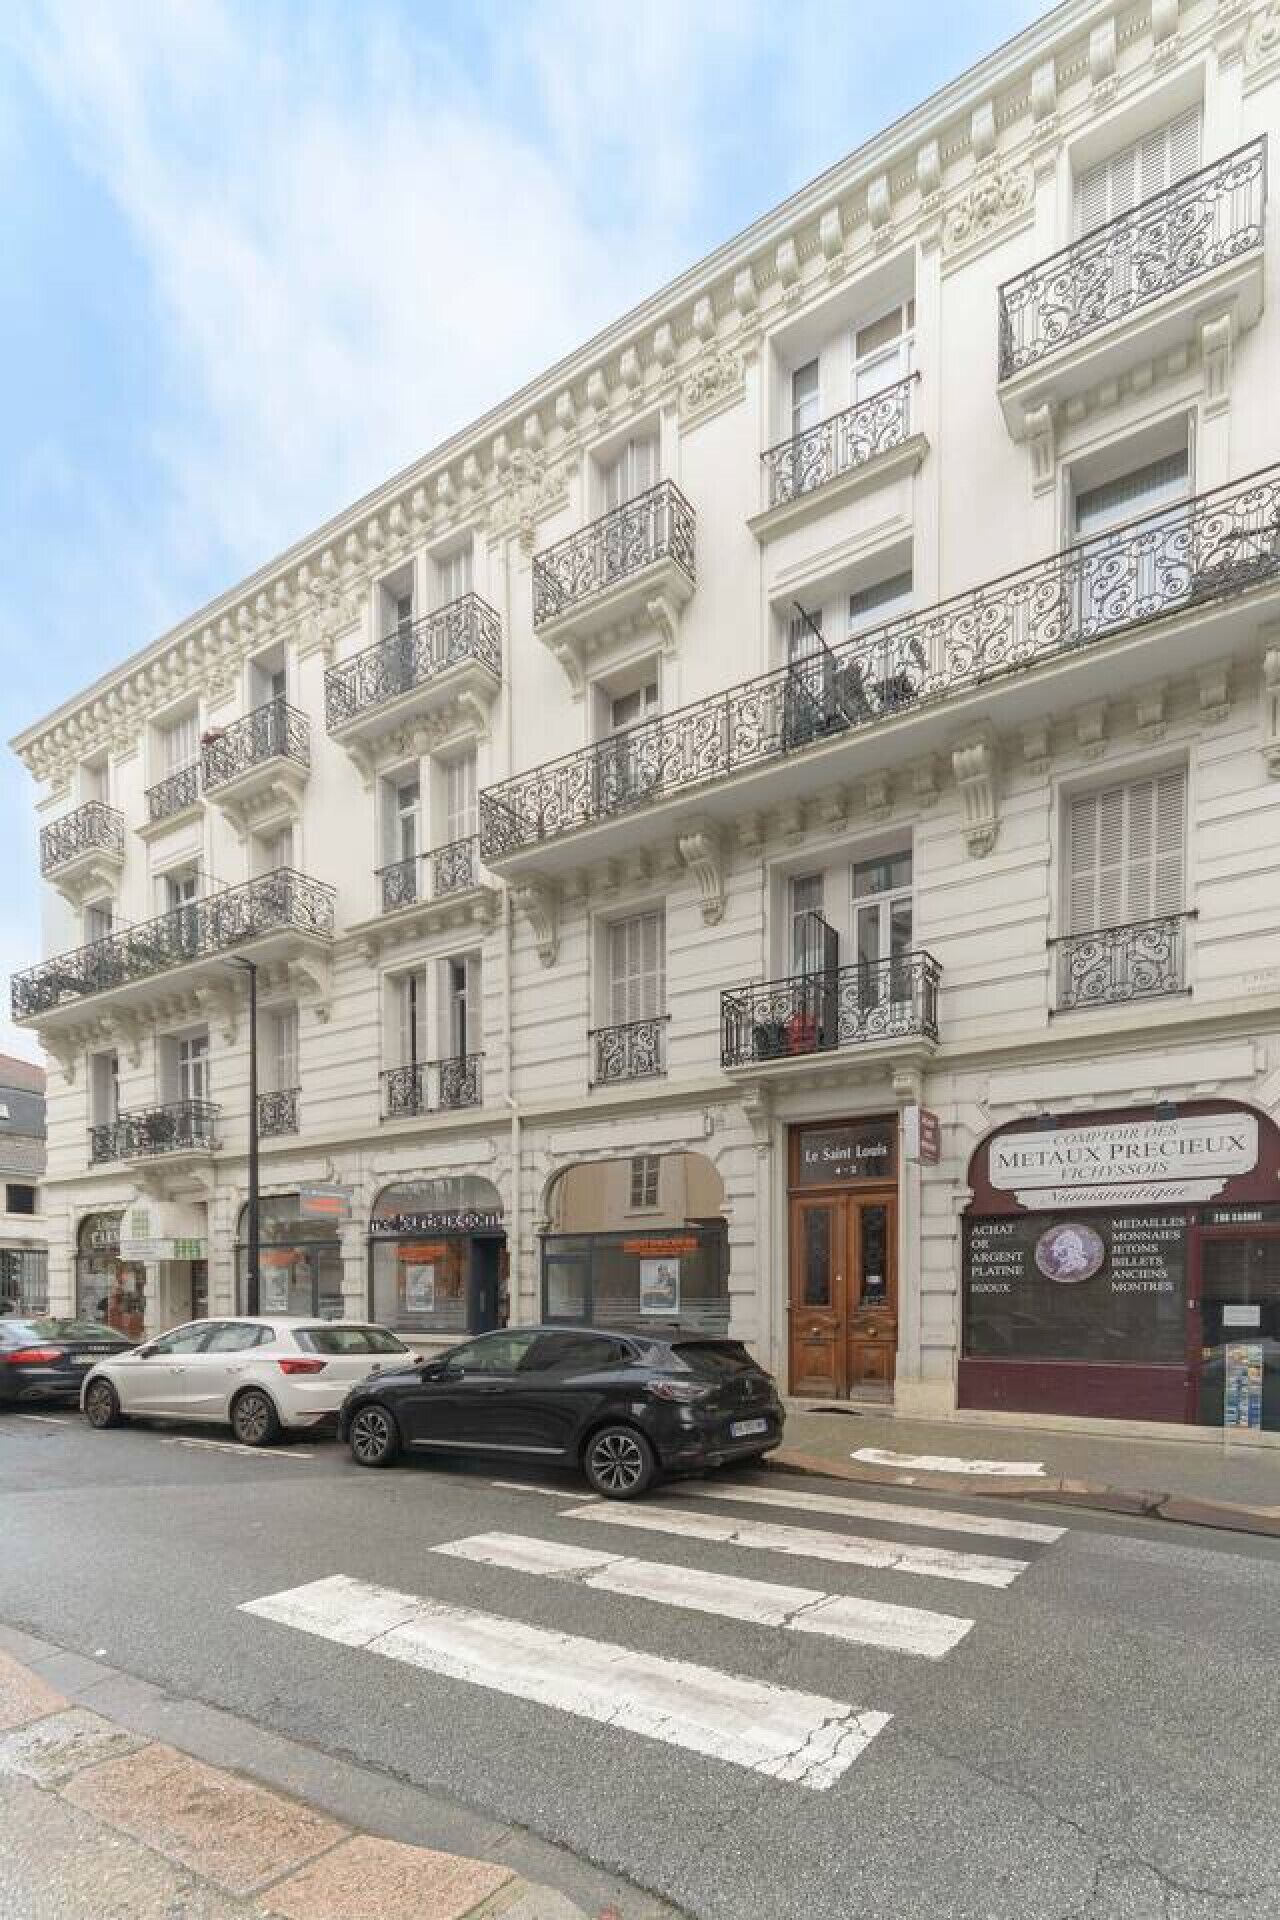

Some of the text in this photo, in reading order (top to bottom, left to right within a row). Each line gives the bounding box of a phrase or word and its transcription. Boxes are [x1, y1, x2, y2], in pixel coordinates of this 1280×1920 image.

[805, 1142, 888, 1163] Le Saint Louis
[999, 1135, 1247, 1169] METAUX PRECIEUX
[971, 1224, 1015, 1236] ACHAT
[1112, 1230, 1181, 1241] MONNAIES
[971, 1240, 989, 1249] OR
[971, 1252, 1023, 1263] ARGENT
[1112, 1256, 1164, 1267] BILLETS
[971, 1265, 1024, 1277] PLATINE
[1112, 1269, 1169, 1280] ANCIENS
